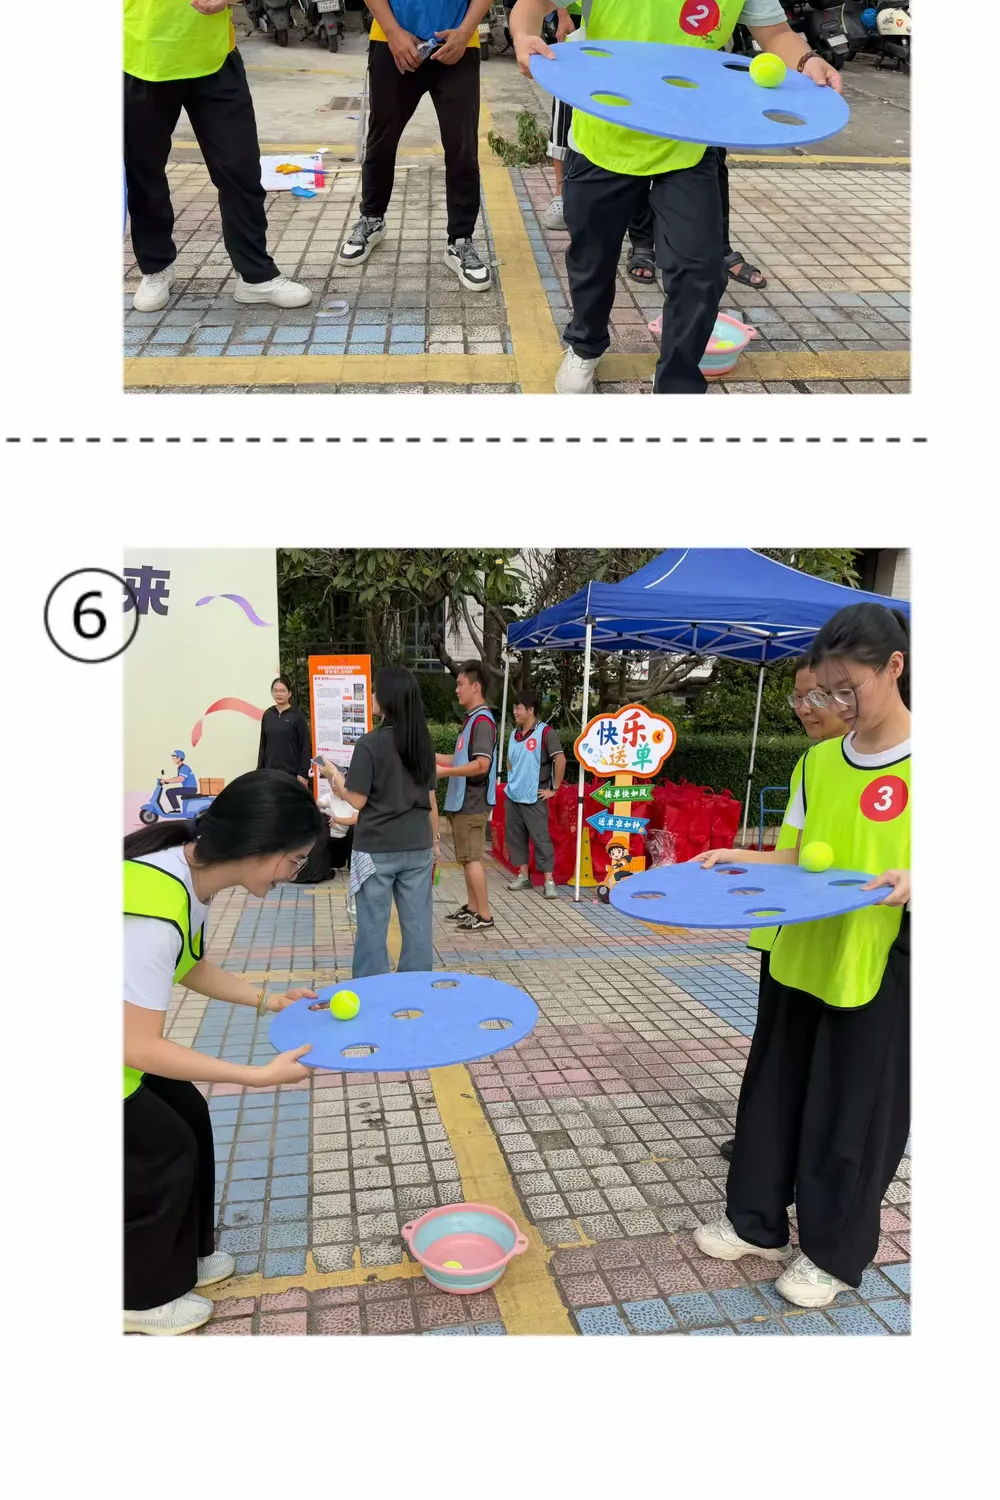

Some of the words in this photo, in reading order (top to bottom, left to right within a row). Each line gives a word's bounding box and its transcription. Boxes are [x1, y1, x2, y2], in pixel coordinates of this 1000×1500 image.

[685, 4, 710, 28] 2
[123, 565, 171, 616] 来
[597, 711, 647, 747] 快乐
[608, 743, 653, 771] 送单
[873, 785, 894, 812] 3
